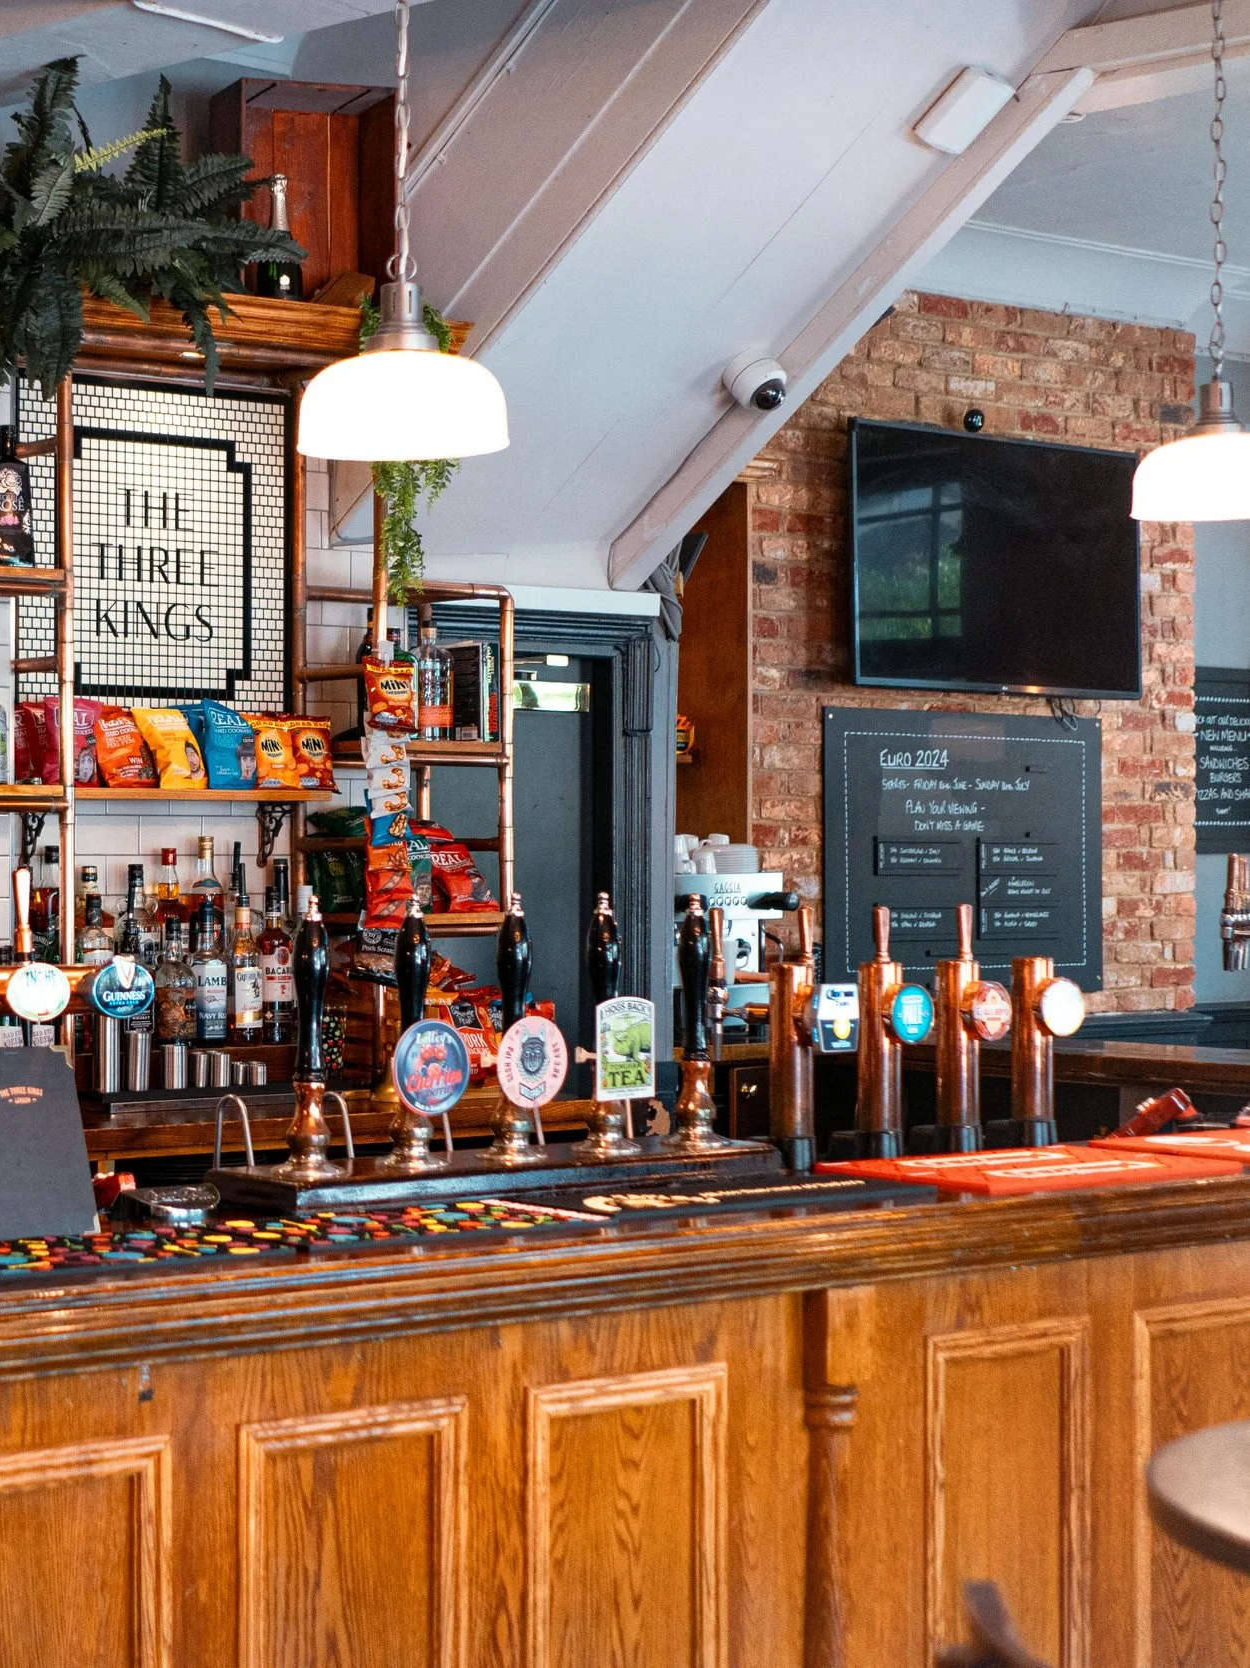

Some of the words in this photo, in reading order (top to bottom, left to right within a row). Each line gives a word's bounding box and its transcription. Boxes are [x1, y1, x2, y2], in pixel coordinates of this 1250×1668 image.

[118, 487, 194, 532] THE
[91, 542, 219, 587] THREE
[96, 599, 214, 643] KINGS
[210, 710, 247, 726] REAL
[1200, 729, 1220, 741] NEW
[1221, 729, 1247, 742] MENU
[129, 756, 144, 764] WIN
[880, 749, 912, 767] EURO
[915, 748, 950, 767] 2024
[1199, 755, 1249, 771] SANDWICHES
[1210, 772, 1243, 784] BURGERS
[905, 799, 926, 814] PLAN
[929, 800, 946, 815] YOUR
[947, 801, 978, 815] VIEWING
[936, 820, 952, 831] MISS
[962, 820, 985, 831] GAME
[430, 854, 462, 866] REAL
[714, 882, 741, 893] GAGGIA
[265, 966, 291, 975] BACAR
[198, 975, 227, 987] LAMB
[102, 990, 146, 1002] GUINNESS
[605, 1003, 626, 1015] HOGS
[627, 1002, 646, 1012] BACK
[199, 1011, 217, 1020] NAVY
[218, 1011, 227, 1020] RU
[505, 1046, 515, 1059] IPA
[608, 1070, 646, 1087] TEA
